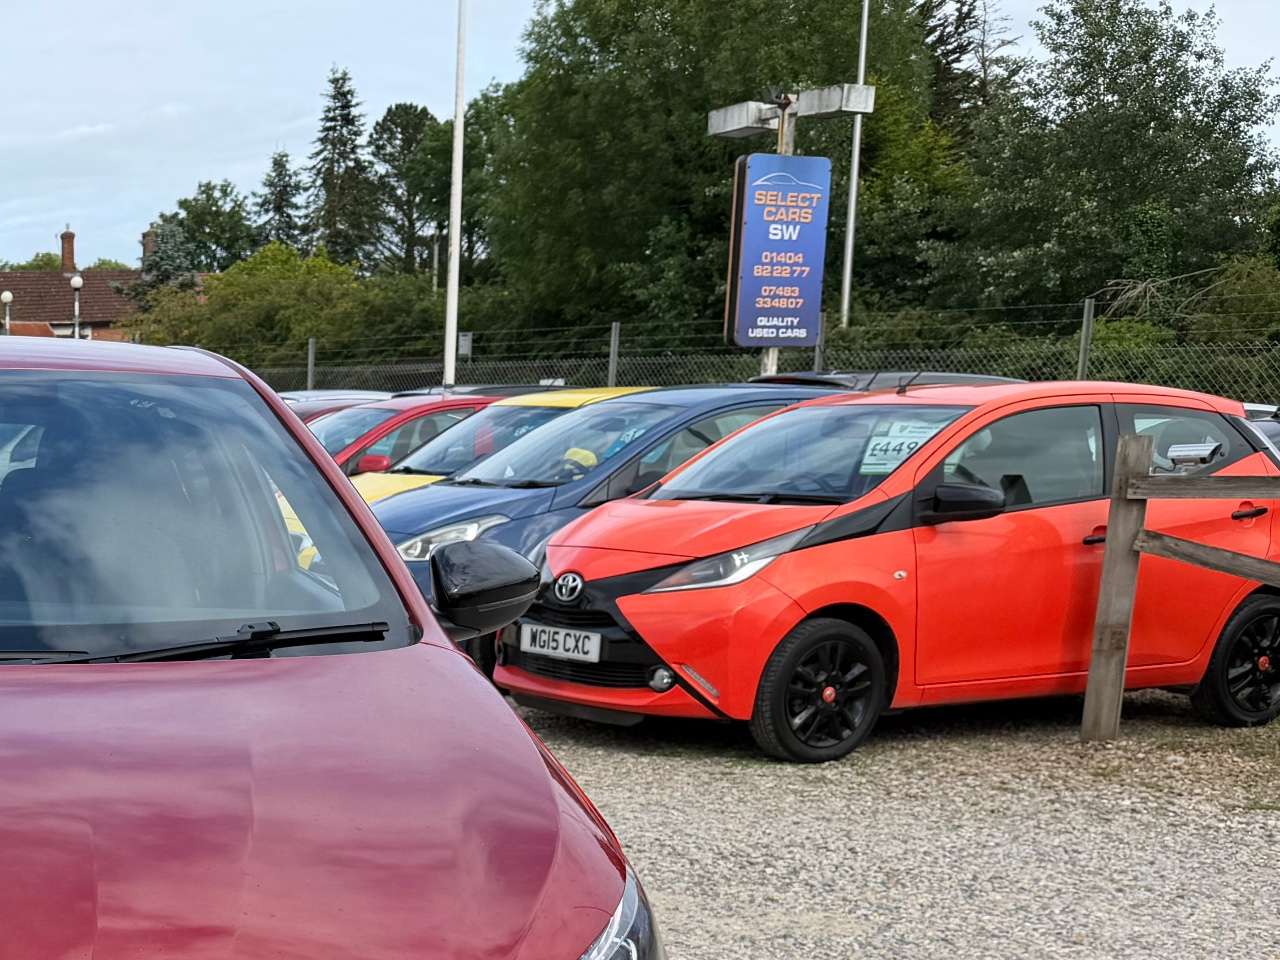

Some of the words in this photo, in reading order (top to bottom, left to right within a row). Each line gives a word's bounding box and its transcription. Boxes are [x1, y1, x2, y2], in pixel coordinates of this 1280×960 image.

[754, 191, 822, 207] SELECT
[763, 207, 813, 223] CARS
[768, 224, 800, 240] SW
[761, 251, 804, 264] 01404
[761, 286, 800, 297] 07483
[755, 298, 804, 309] 334807
[757, 316, 800, 326] QUALITY
[748, 328, 777, 337] USED
[778, 328, 807, 338] CARS
[530, 628, 559, 651] WG15
[563, 633, 590, 655] CXC
